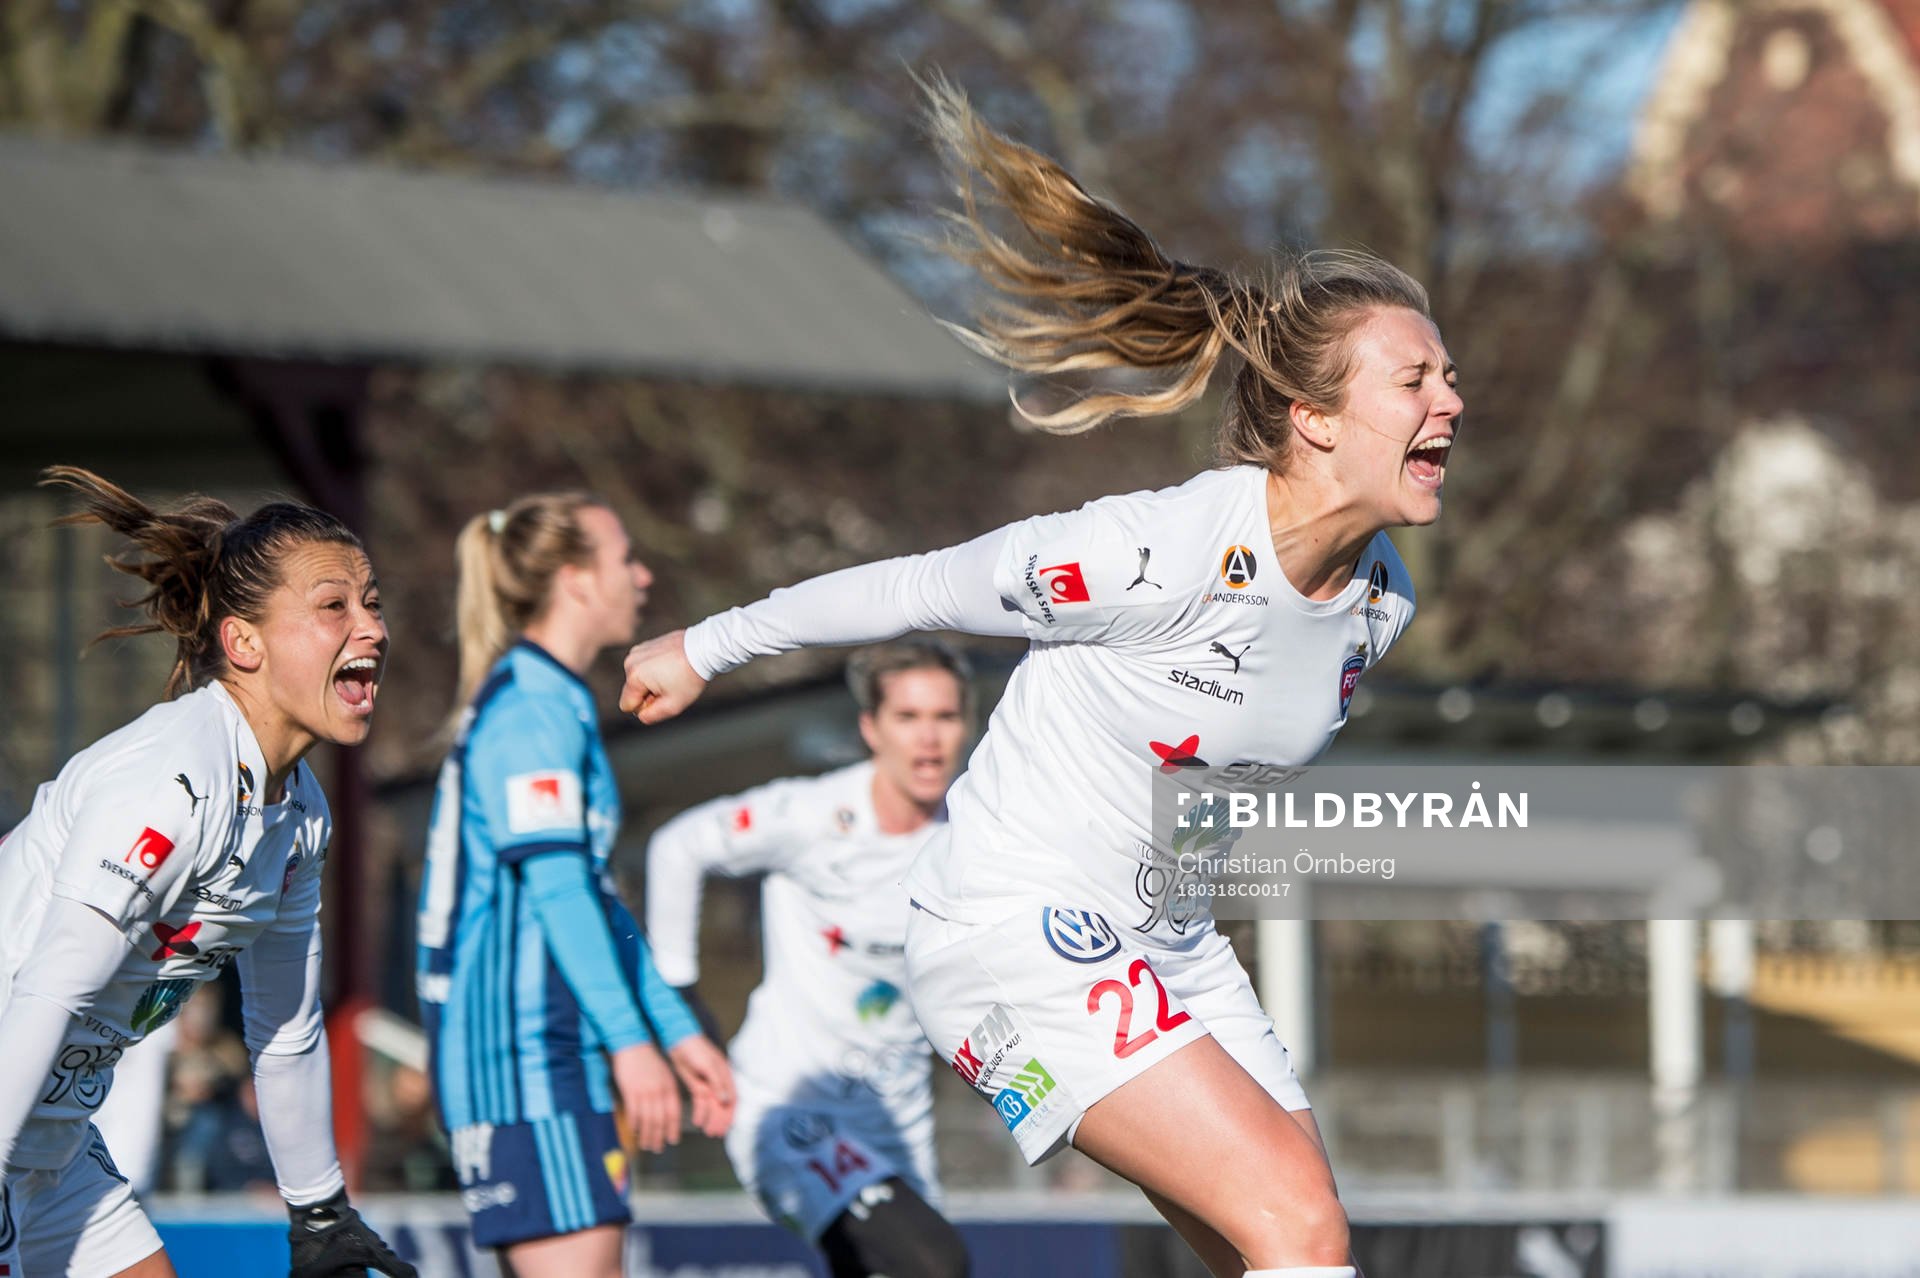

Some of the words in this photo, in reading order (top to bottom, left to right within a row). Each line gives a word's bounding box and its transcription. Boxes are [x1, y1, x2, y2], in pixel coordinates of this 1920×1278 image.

[1025, 554, 1043, 599] SVENSKA
[1038, 600, 1056, 624] SPEL
[1168, 669, 1245, 705] stadium
[1087, 959, 1192, 1059] 22
[807, 1143, 871, 1194] 14
